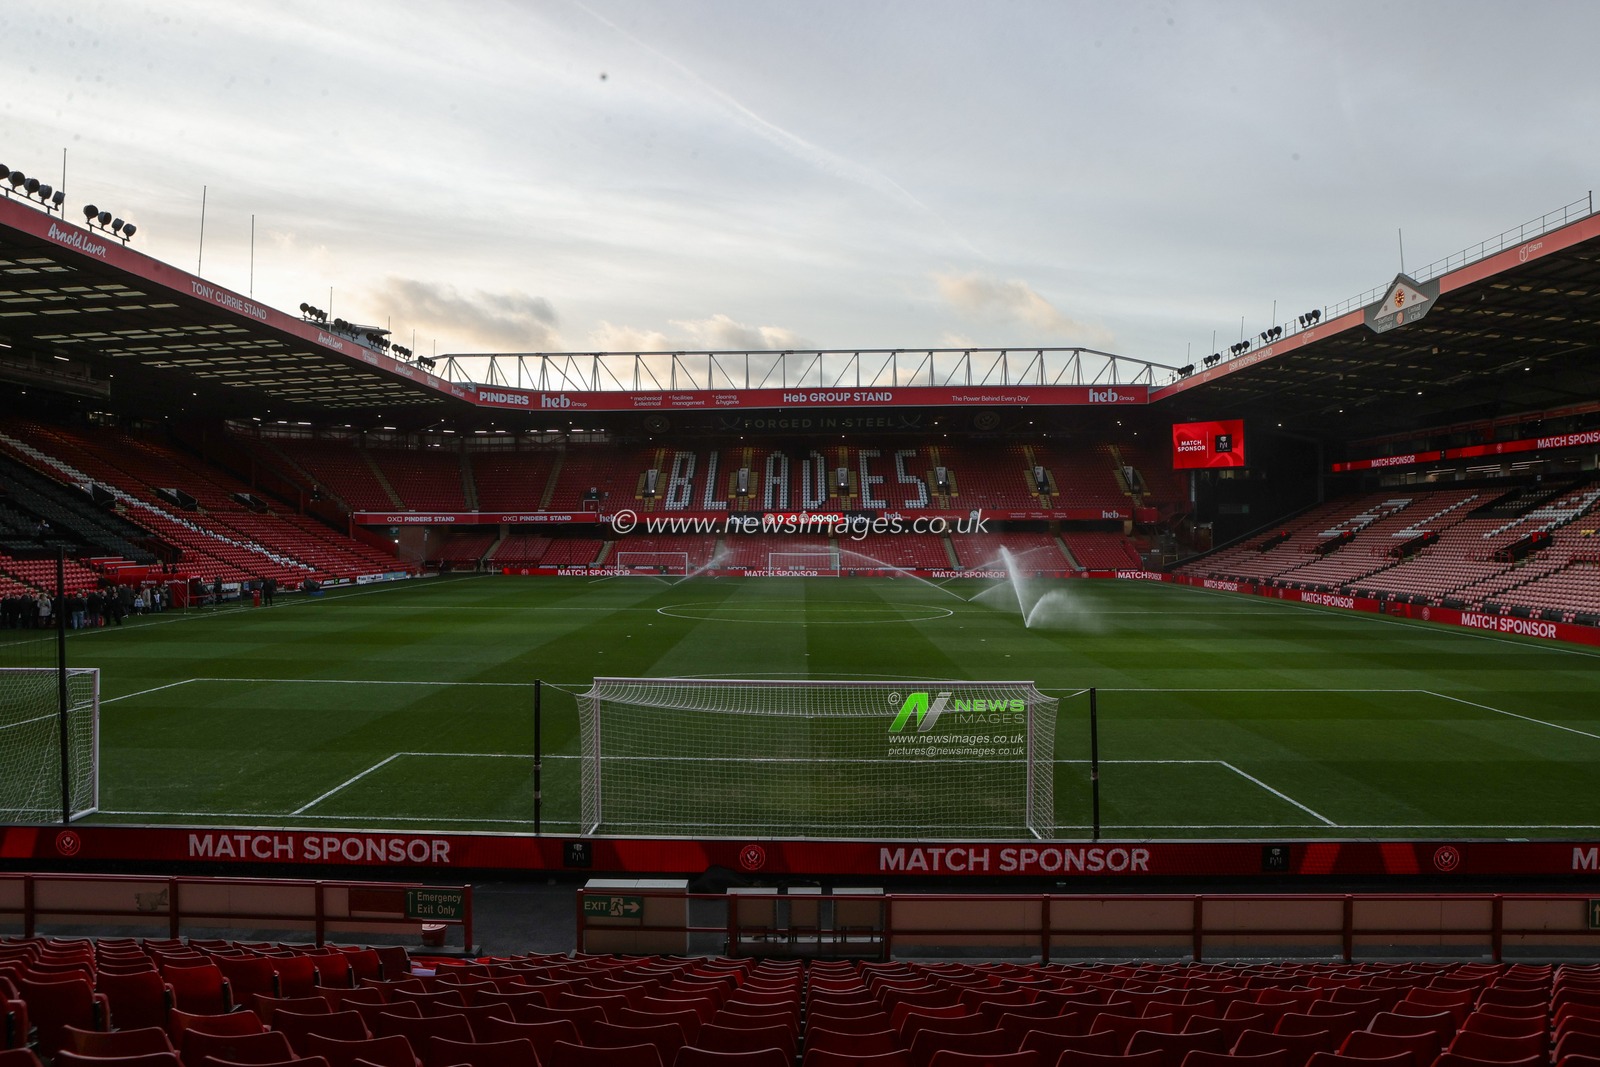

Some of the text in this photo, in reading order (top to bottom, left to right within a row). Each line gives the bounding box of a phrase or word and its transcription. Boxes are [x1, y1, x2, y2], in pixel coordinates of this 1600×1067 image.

[48, 222, 107, 258] Arnold Laver
[1528, 242, 1543, 253] dsm
[191, 281, 267, 320] TONY CURRIE STAND
[1258, 347, 1273, 362] STAND
[480, 391, 530, 405] PINDERS
[541, 394, 571, 408] heb
[783, 392, 892, 403] Heb GROUP STAND
[1001, 395, 1017, 403] Every
[1088, 388, 1118, 402] heb
[745, 416, 895, 429] FORGED IN STEEL
[1181, 439, 1202, 447] MATCH
[1537, 431, 1600, 449] MATCH SPONS
[1177, 445, 1206, 453] SPONSOR
[1371, 454, 1415, 468] MATCH SPONSOR
[665, 450, 929, 510] BLADES
[404, 515, 432, 523] PINDERS
[434, 515, 455, 523] STAND
[549, 514, 572, 522] STAND
[1102, 510, 1119, 519] heb
[589, 569, 631, 577] SPONSOR
[963, 571, 1006, 579] SPONSOR
[1118, 571, 1163, 581] MATCH SPONSOR
[1203, 579, 1238, 591] MATCH SPONSOR
[1301, 592, 1354, 609] MATCH SPONSOR
[1461, 612, 1557, 639] MATCH SPONSOR
[188, 833, 451, 863] MATCH SPONSOR
[879, 847, 1150, 872] MATCH SPONSOR
[417, 891, 462, 904] Emergency
[417, 903, 456, 916] Exit Only
[584, 901, 608, 911] EXIT
